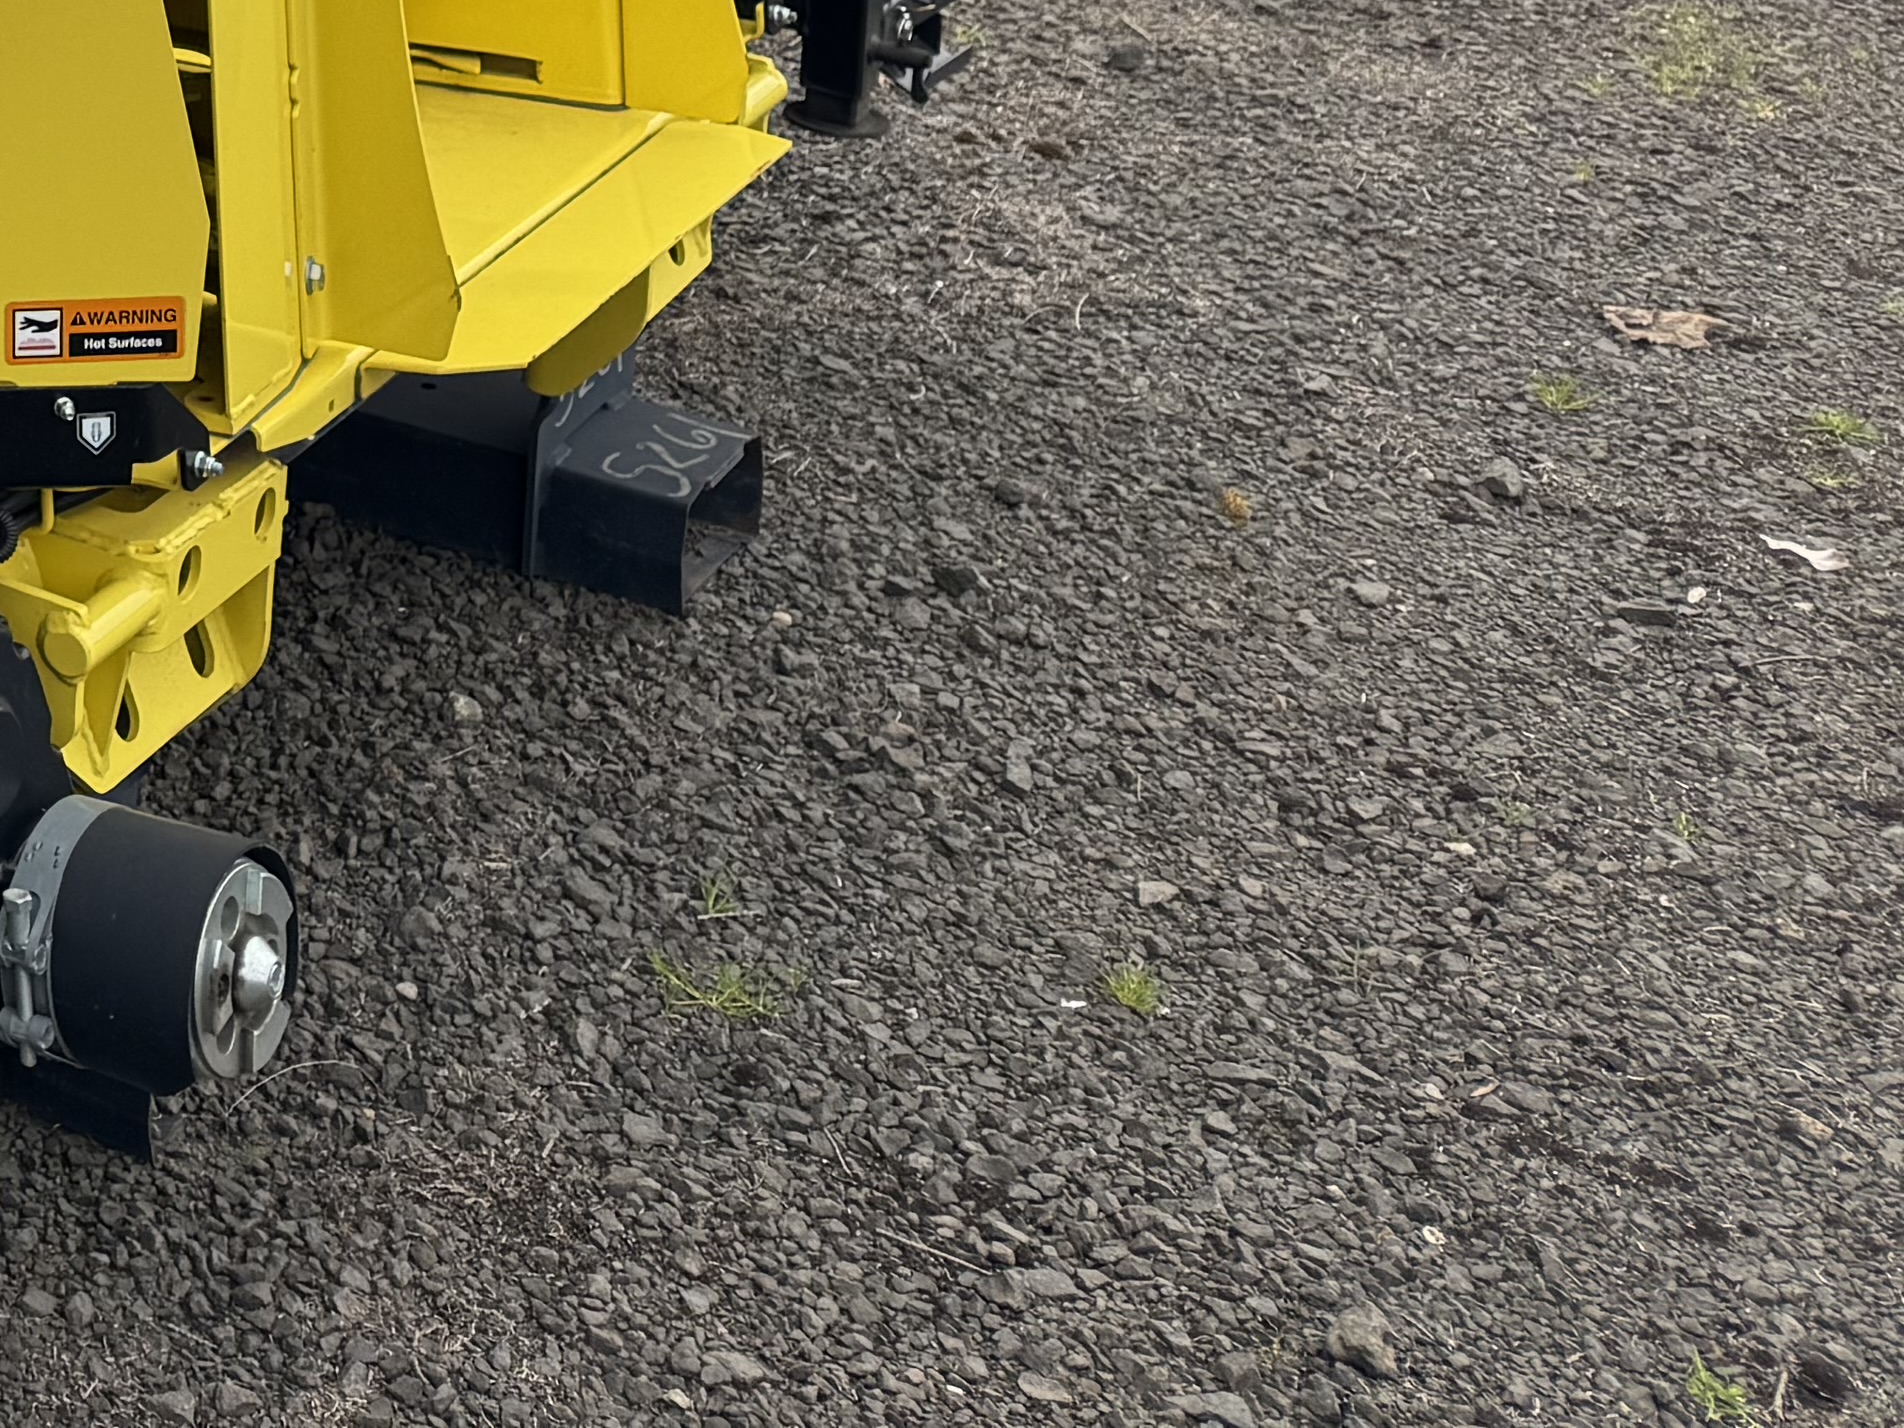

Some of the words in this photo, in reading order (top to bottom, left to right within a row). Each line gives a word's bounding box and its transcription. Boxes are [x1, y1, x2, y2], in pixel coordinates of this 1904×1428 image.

[88, 308, 176, 325] WARNING
[84, 338, 105, 349] Hot
[108, 337, 162, 349] Surfaces
